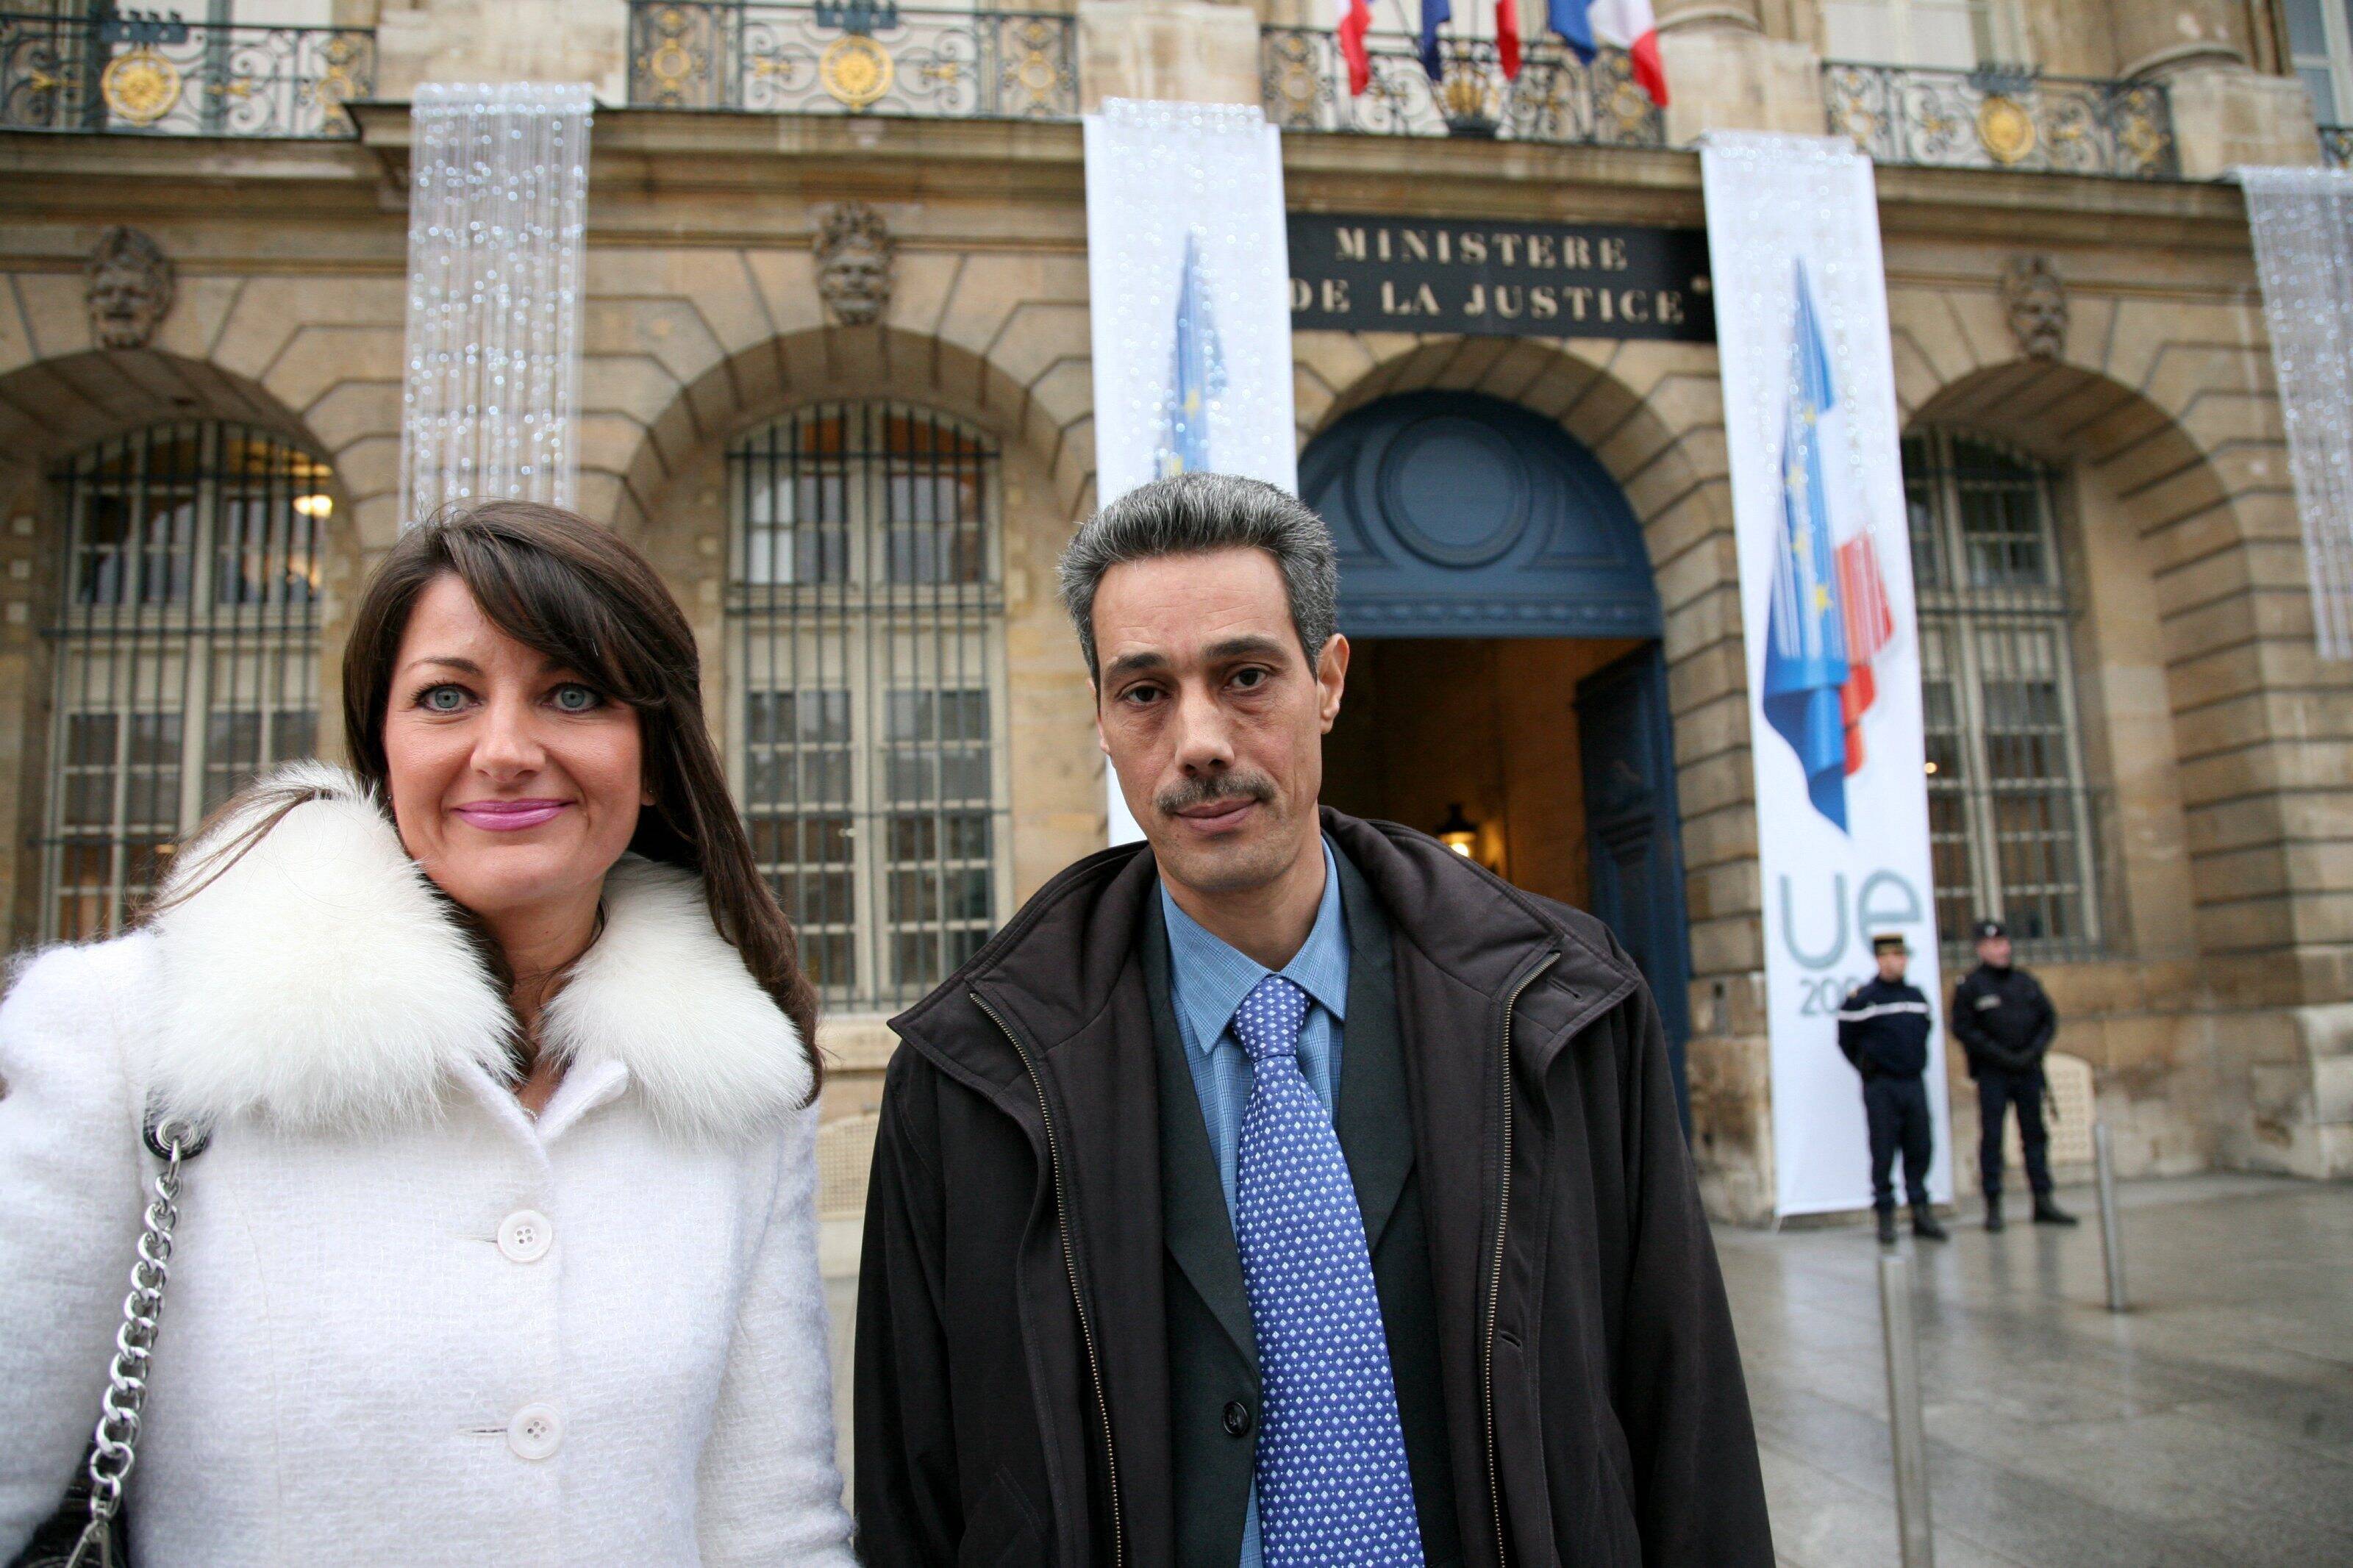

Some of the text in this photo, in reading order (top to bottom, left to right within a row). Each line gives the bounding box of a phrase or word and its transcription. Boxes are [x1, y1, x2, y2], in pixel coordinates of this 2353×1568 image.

[1335, 226, 1627, 271] MINISTERE
[1289, 277, 1685, 323] DE LA JUSTICE
